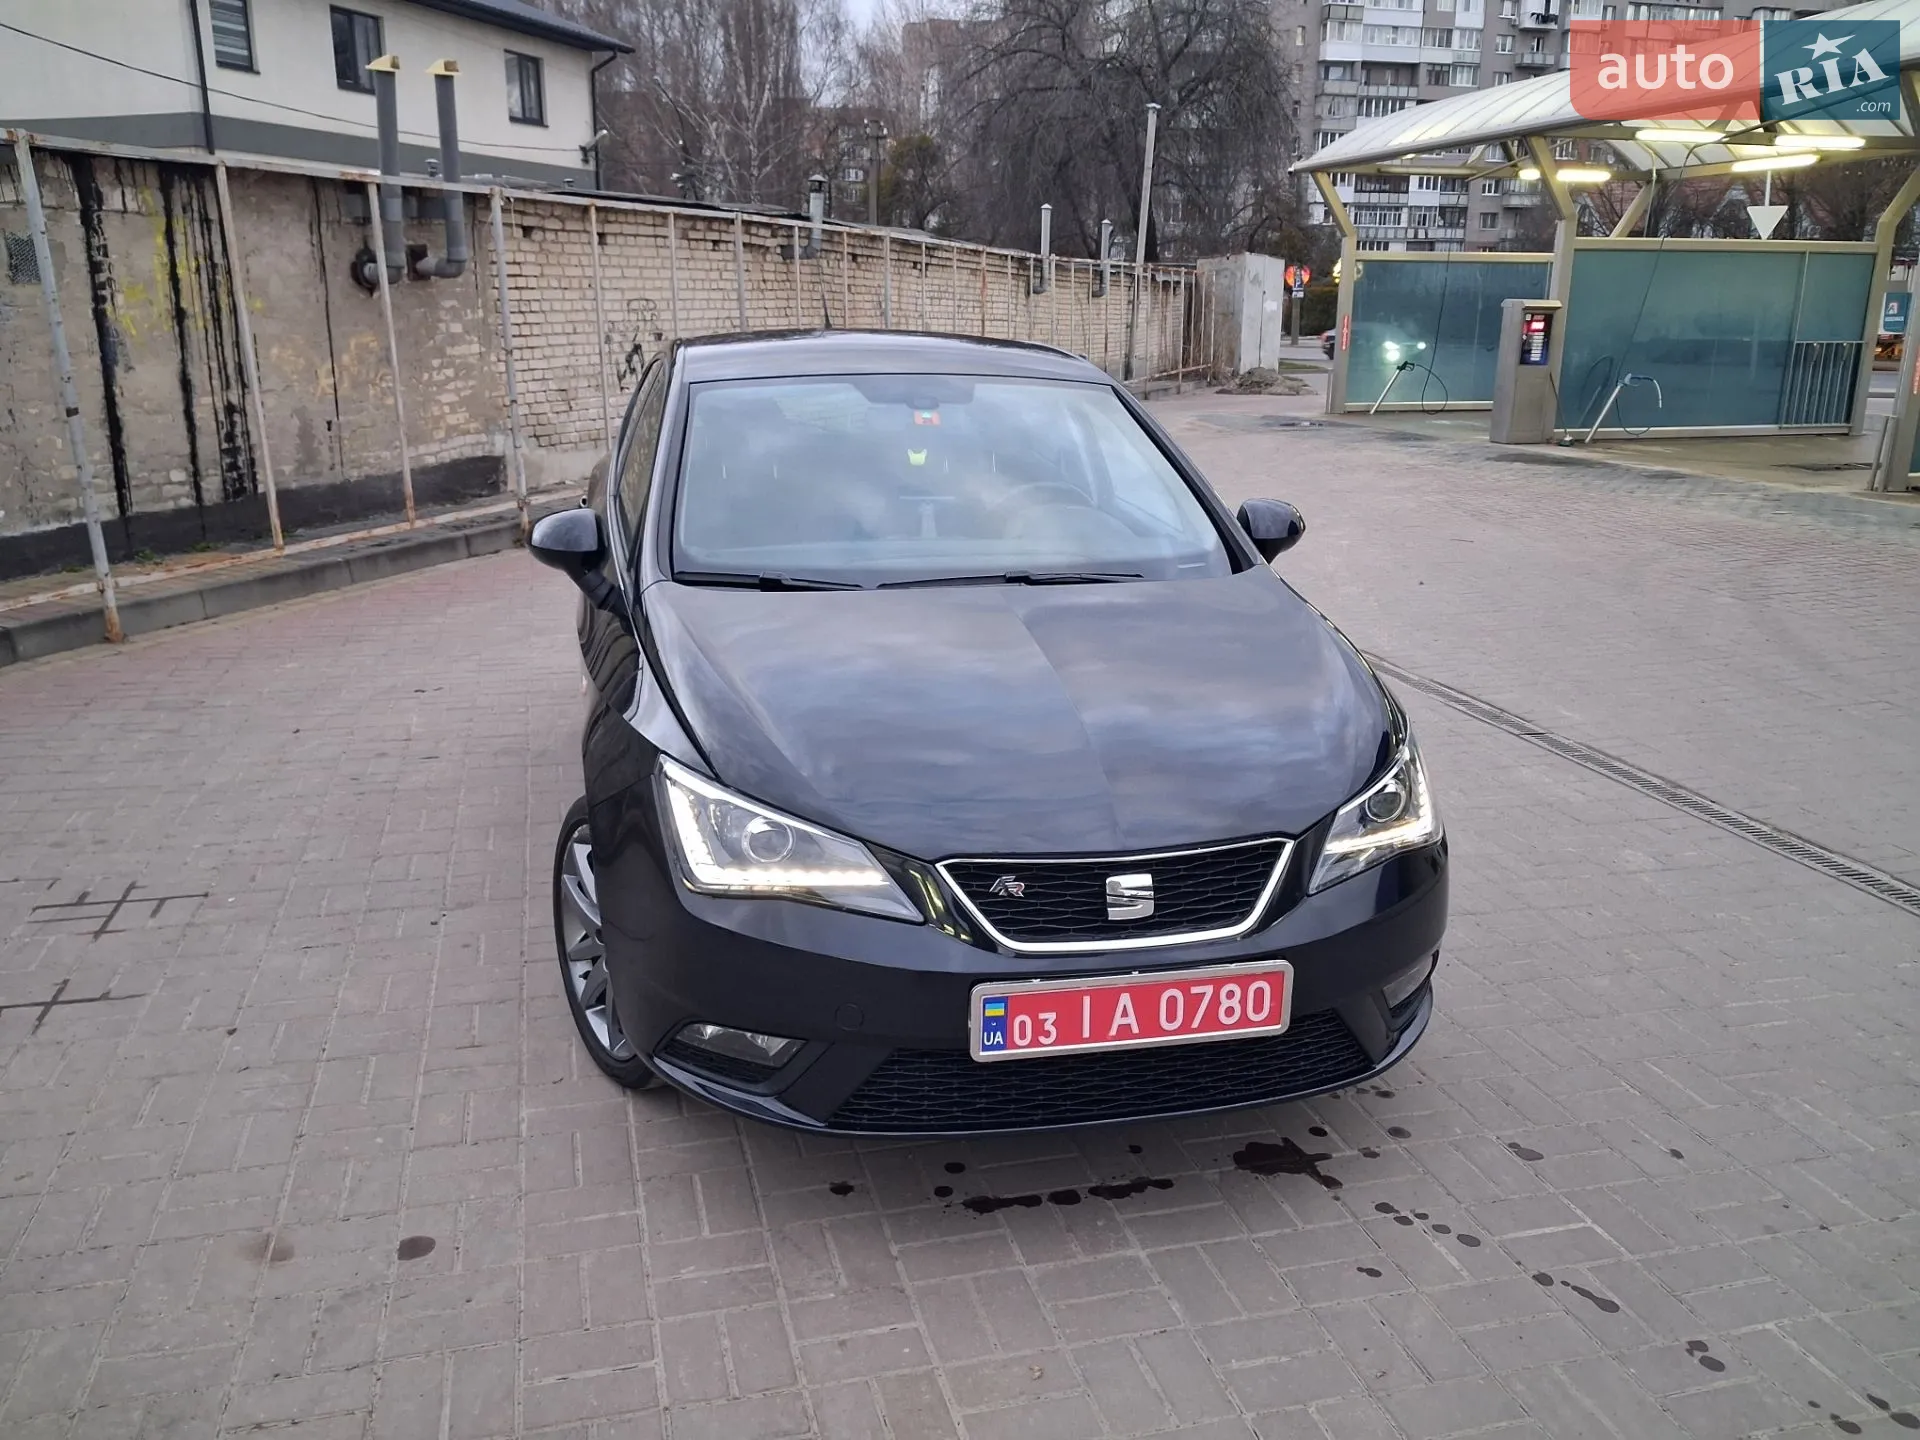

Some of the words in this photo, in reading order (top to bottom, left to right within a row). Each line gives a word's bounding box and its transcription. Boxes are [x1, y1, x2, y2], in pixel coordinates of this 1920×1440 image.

[1013, 1012, 1057, 1047] 03
[1158, 980, 1272, 1032] 0780
[984, 1031, 1004, 1046] UA
